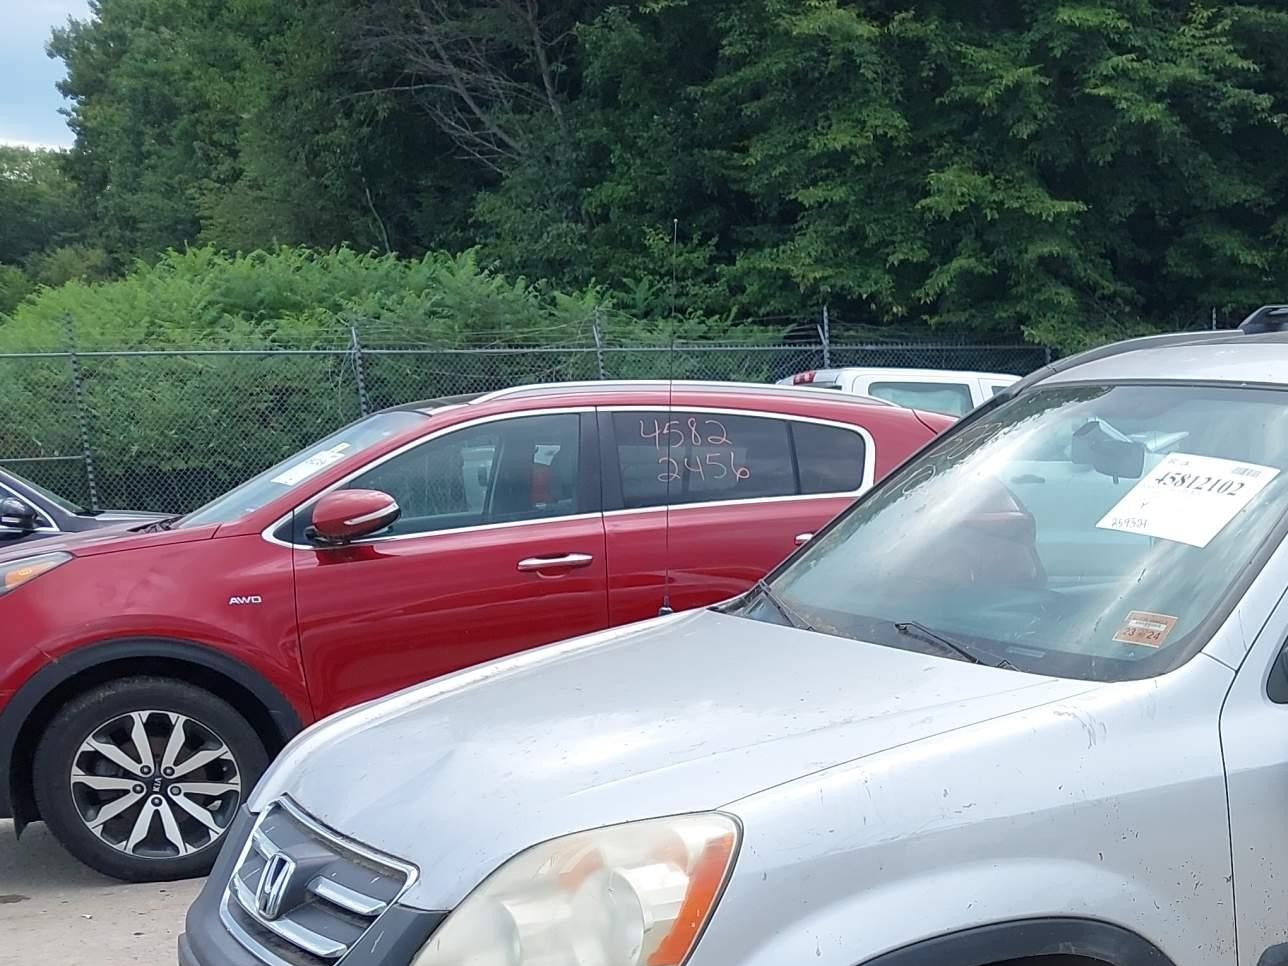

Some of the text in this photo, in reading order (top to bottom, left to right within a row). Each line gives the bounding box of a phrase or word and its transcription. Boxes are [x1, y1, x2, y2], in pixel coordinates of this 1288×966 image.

[639, 417, 733, 449] 4582
[657, 450, 751, 483] 2456
[1154, 471, 1246, 496] 45812102
[228, 595, 263, 606] AWD
[151, 777, 163, 793] KIA
